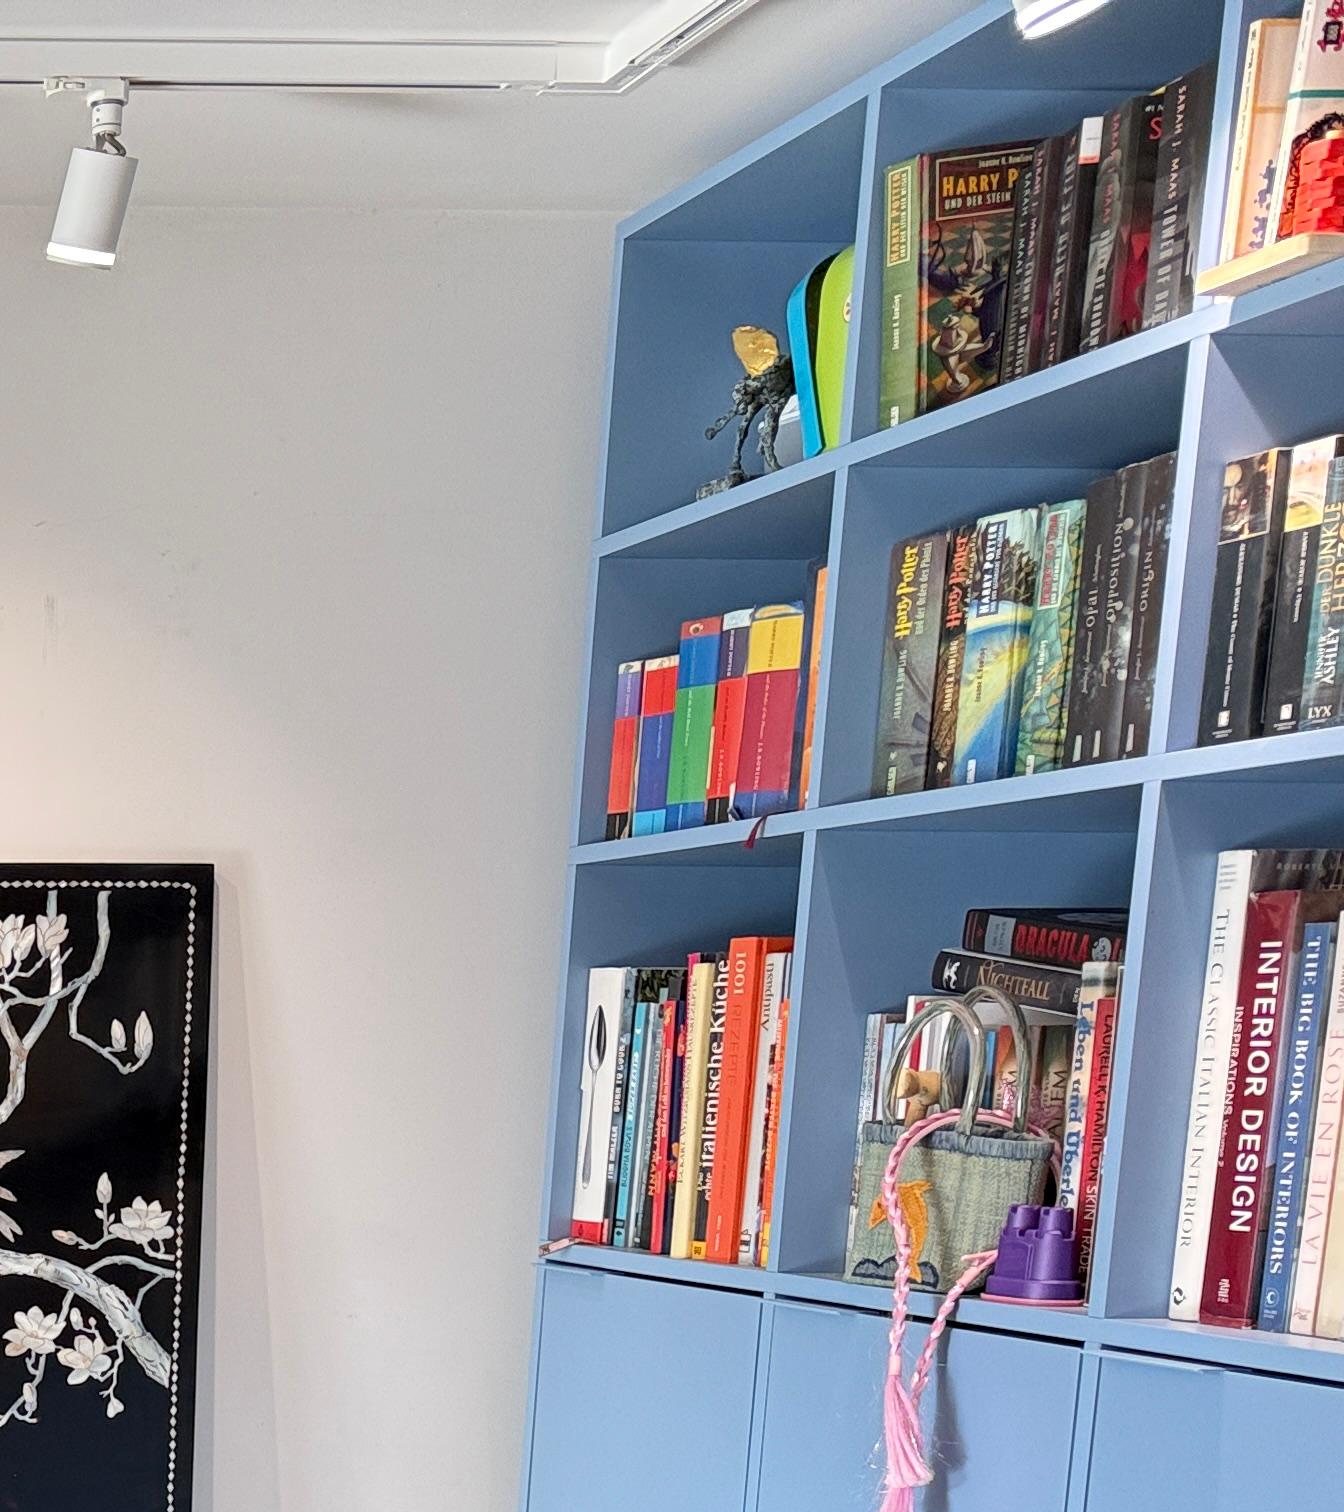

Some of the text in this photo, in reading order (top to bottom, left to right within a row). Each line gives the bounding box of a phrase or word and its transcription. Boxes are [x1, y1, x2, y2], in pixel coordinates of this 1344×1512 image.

[1173, 85, 1187, 135] SARAH
[942, 173, 1000, 198] HARRY
[944, 198, 963, 210] UND
[966, 195, 983, 208] DER
[1033, 151, 1044, 195] SARAH
[1168, 157, 1180, 200] MAAS
[890, 172, 901, 262] HARRY POTTER
[1016, 171, 1032, 275] SARAH MAAS
[1103, 183, 1114, 224] MAAS
[1159, 204, 1178, 260] TOWER
[1027, 217, 1038, 256] MAAS
[1052, 281, 1062, 320] MAAS
[1156, 265, 1172, 284] OF
[1020, 306, 1029, 319] OF
[1089, 294, 1104, 350] SHADOW
[1015, 324, 1027, 380] MIDNIGH
[946, 535, 969, 629] Harry Potter
[978, 523, 999, 614] HARRY POTTER
[1139, 551, 1154, 612] ORIGIN
[1318, 501, 1342, 613] DER DUNKLE
[894, 545, 919, 640] Harry Potter
[896, 649, 908, 682] ROWLING
[947, 639, 959, 674] ROWLING
[1321, 626, 1340, 685] ASHLEY
[1307, 705, 1332, 719] LYX
[1015, 923, 1091, 963] DRACULA
[1212, 908, 1230, 956] THE
[710, 959, 730, 1033] Küche
[760, 963, 775, 1031] Antipasti
[977, 960, 1051, 1001] NIGHTFALL
[1204, 962, 1224, 1046] CLASSIC
[727, 952, 747, 1086] 1001 REZEPTE
[1098, 1014, 1114, 1081] LAURELL
[613, 1045, 626, 1113] BORN TO COOK
[1223, 1005, 1245, 1116] INSPIRATIONS
[1228, 940, 1283, 1233] INTERIOR DESIGN
[1059, 1001, 1094, 1209] Leben und Überle
[1192, 1057, 1215, 1138] ITALIAN
[1269, 936, 1322, 1274] THE BIG BOOK OF INTERIORS
[607, 1160, 615, 1179] TIM
[621, 1125, 633, 1187] BUDDHA BOWLS
[1086, 1100, 1108, 1182] HAMILTON
[1302, 1028, 1343, 1265] LA VIE EN ROSE
[1084, 1185, 1098, 1221] SKIN
[1179, 1147, 1205, 1249] INTERIOR
[1078, 1223, 1095, 1274] TRADE
